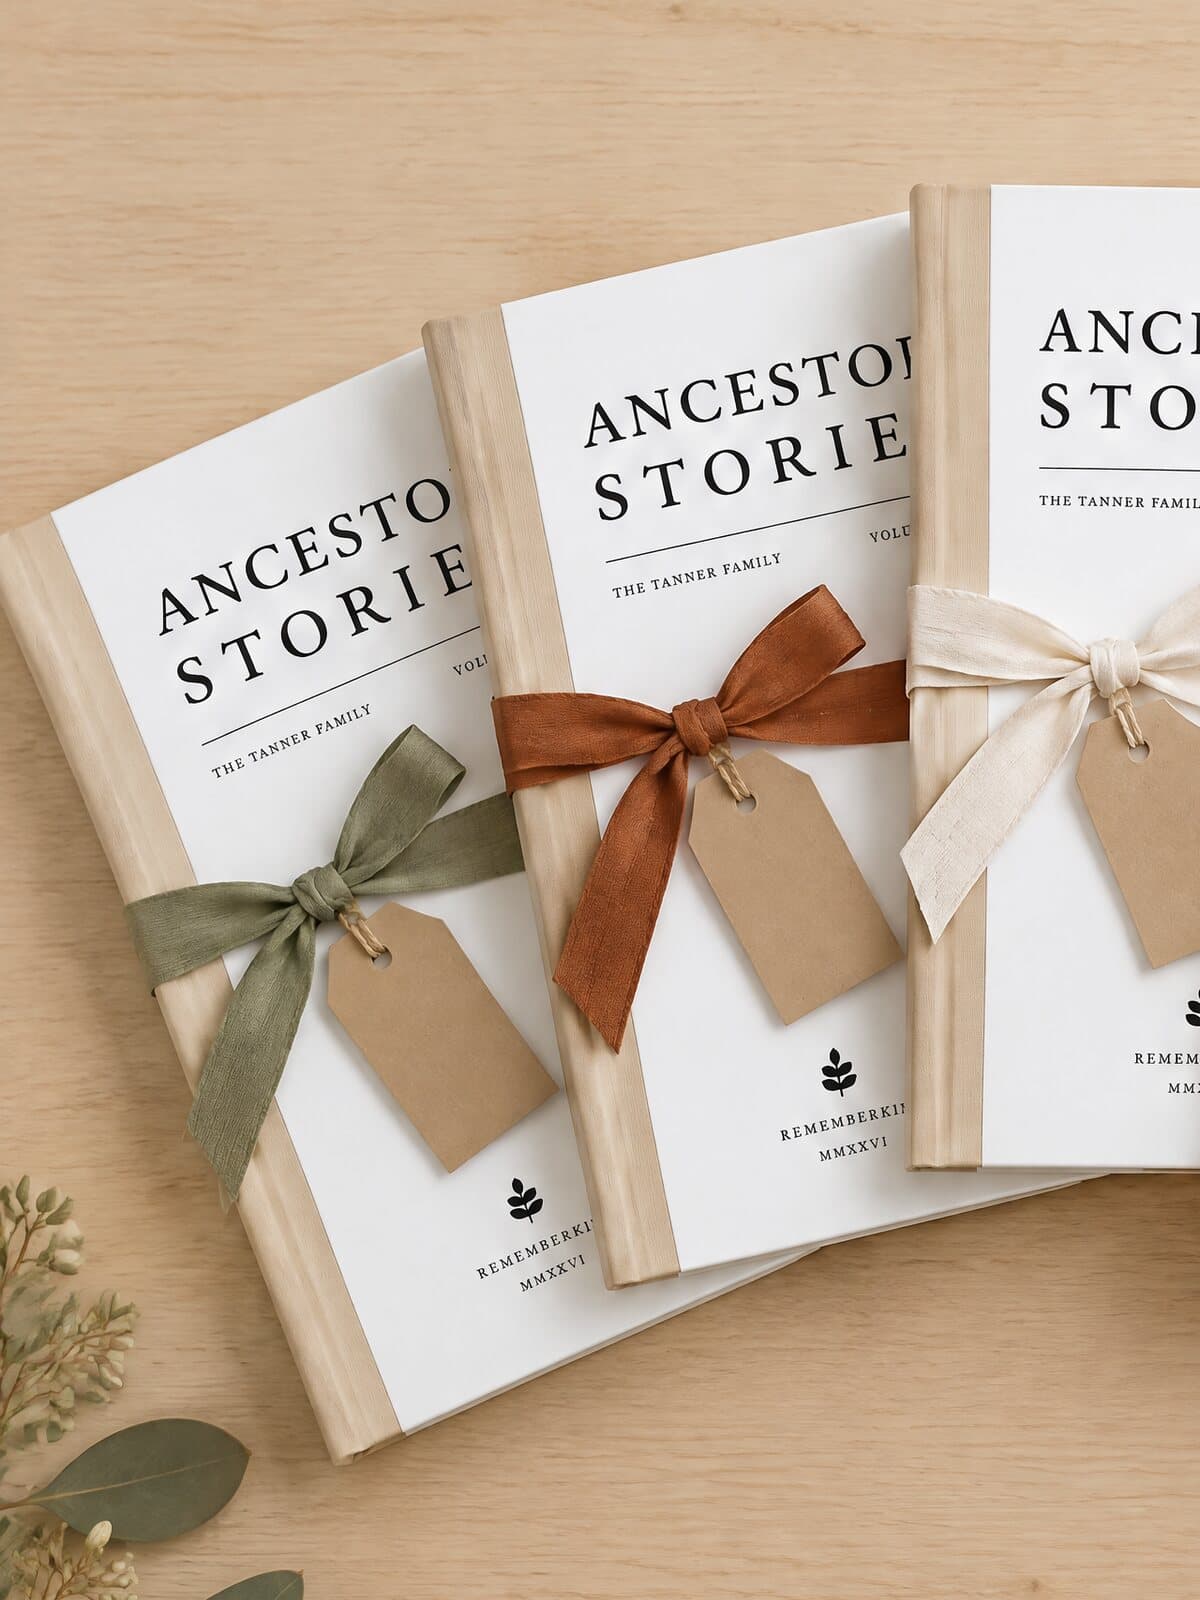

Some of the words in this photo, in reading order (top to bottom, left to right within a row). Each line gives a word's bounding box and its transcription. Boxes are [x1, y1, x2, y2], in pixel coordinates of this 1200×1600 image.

[595, 413, 906, 521] STORIE
[1038, 494, 1072, 507] THE
[1077, 495, 1145, 509] TANNER
[159, 479, 450, 636] ANCESTO
[868, 524, 912, 544] VOLU
[611, 581, 646, 599] THE
[650, 567, 718, 591] TANNER
[721, 552, 781, 576] FAMILY
[177, 544, 472, 704] STORIE
[452, 653, 489, 676] VOL
[211, 757, 246, 779] THE
[247, 729, 312, 763] TANNER
[314, 703, 371, 736] FAMILY
[818, 1135, 888, 1162] MMXXVI
[475, 1218, 596, 1280] REMEMBERKI
[519, 1254, 585, 1293] MMXXVI
